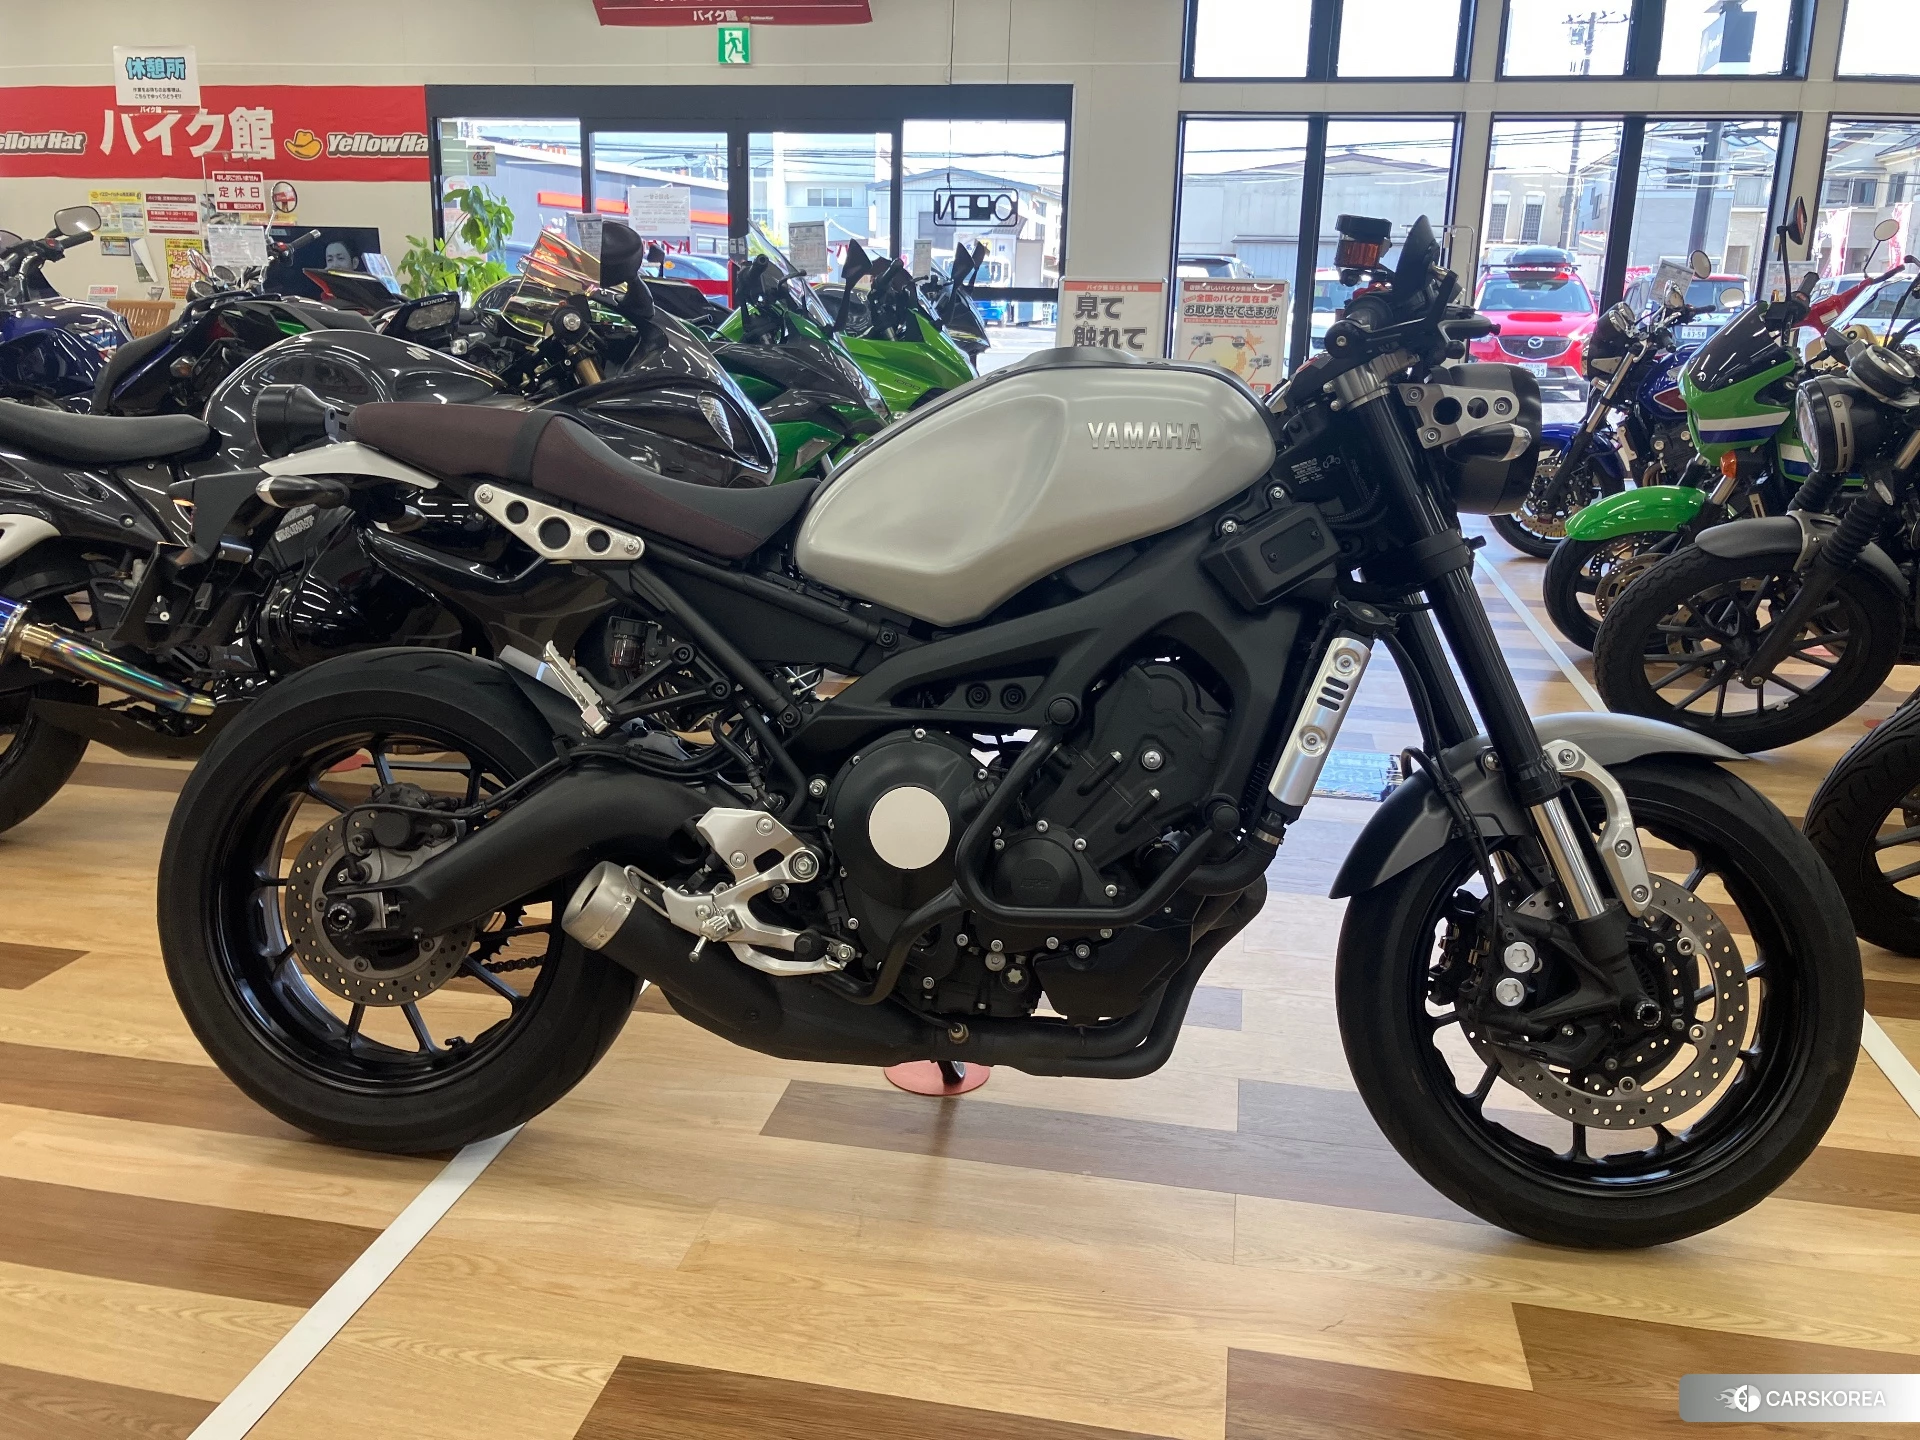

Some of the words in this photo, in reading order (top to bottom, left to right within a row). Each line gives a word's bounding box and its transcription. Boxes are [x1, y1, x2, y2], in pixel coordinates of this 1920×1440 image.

[693, 10, 738, 21] バイク館
[125, 57, 186, 80] 休憩所
[100, 106, 276, 160] バイク館
[328, 134, 429, 152] YellowHa
[218, 186, 260, 198] 定休日
[420, 296, 448, 307] HONDA
[1074, 296, 1123, 319] 見て
[1196, 293, 1269, 304] 全国のバイク館在庫
[1184, 304, 1279, 319] お取り寄せできます!
[1073, 326, 1146, 350] 触れて
[1087, 421, 1202, 450] YAMAHA
